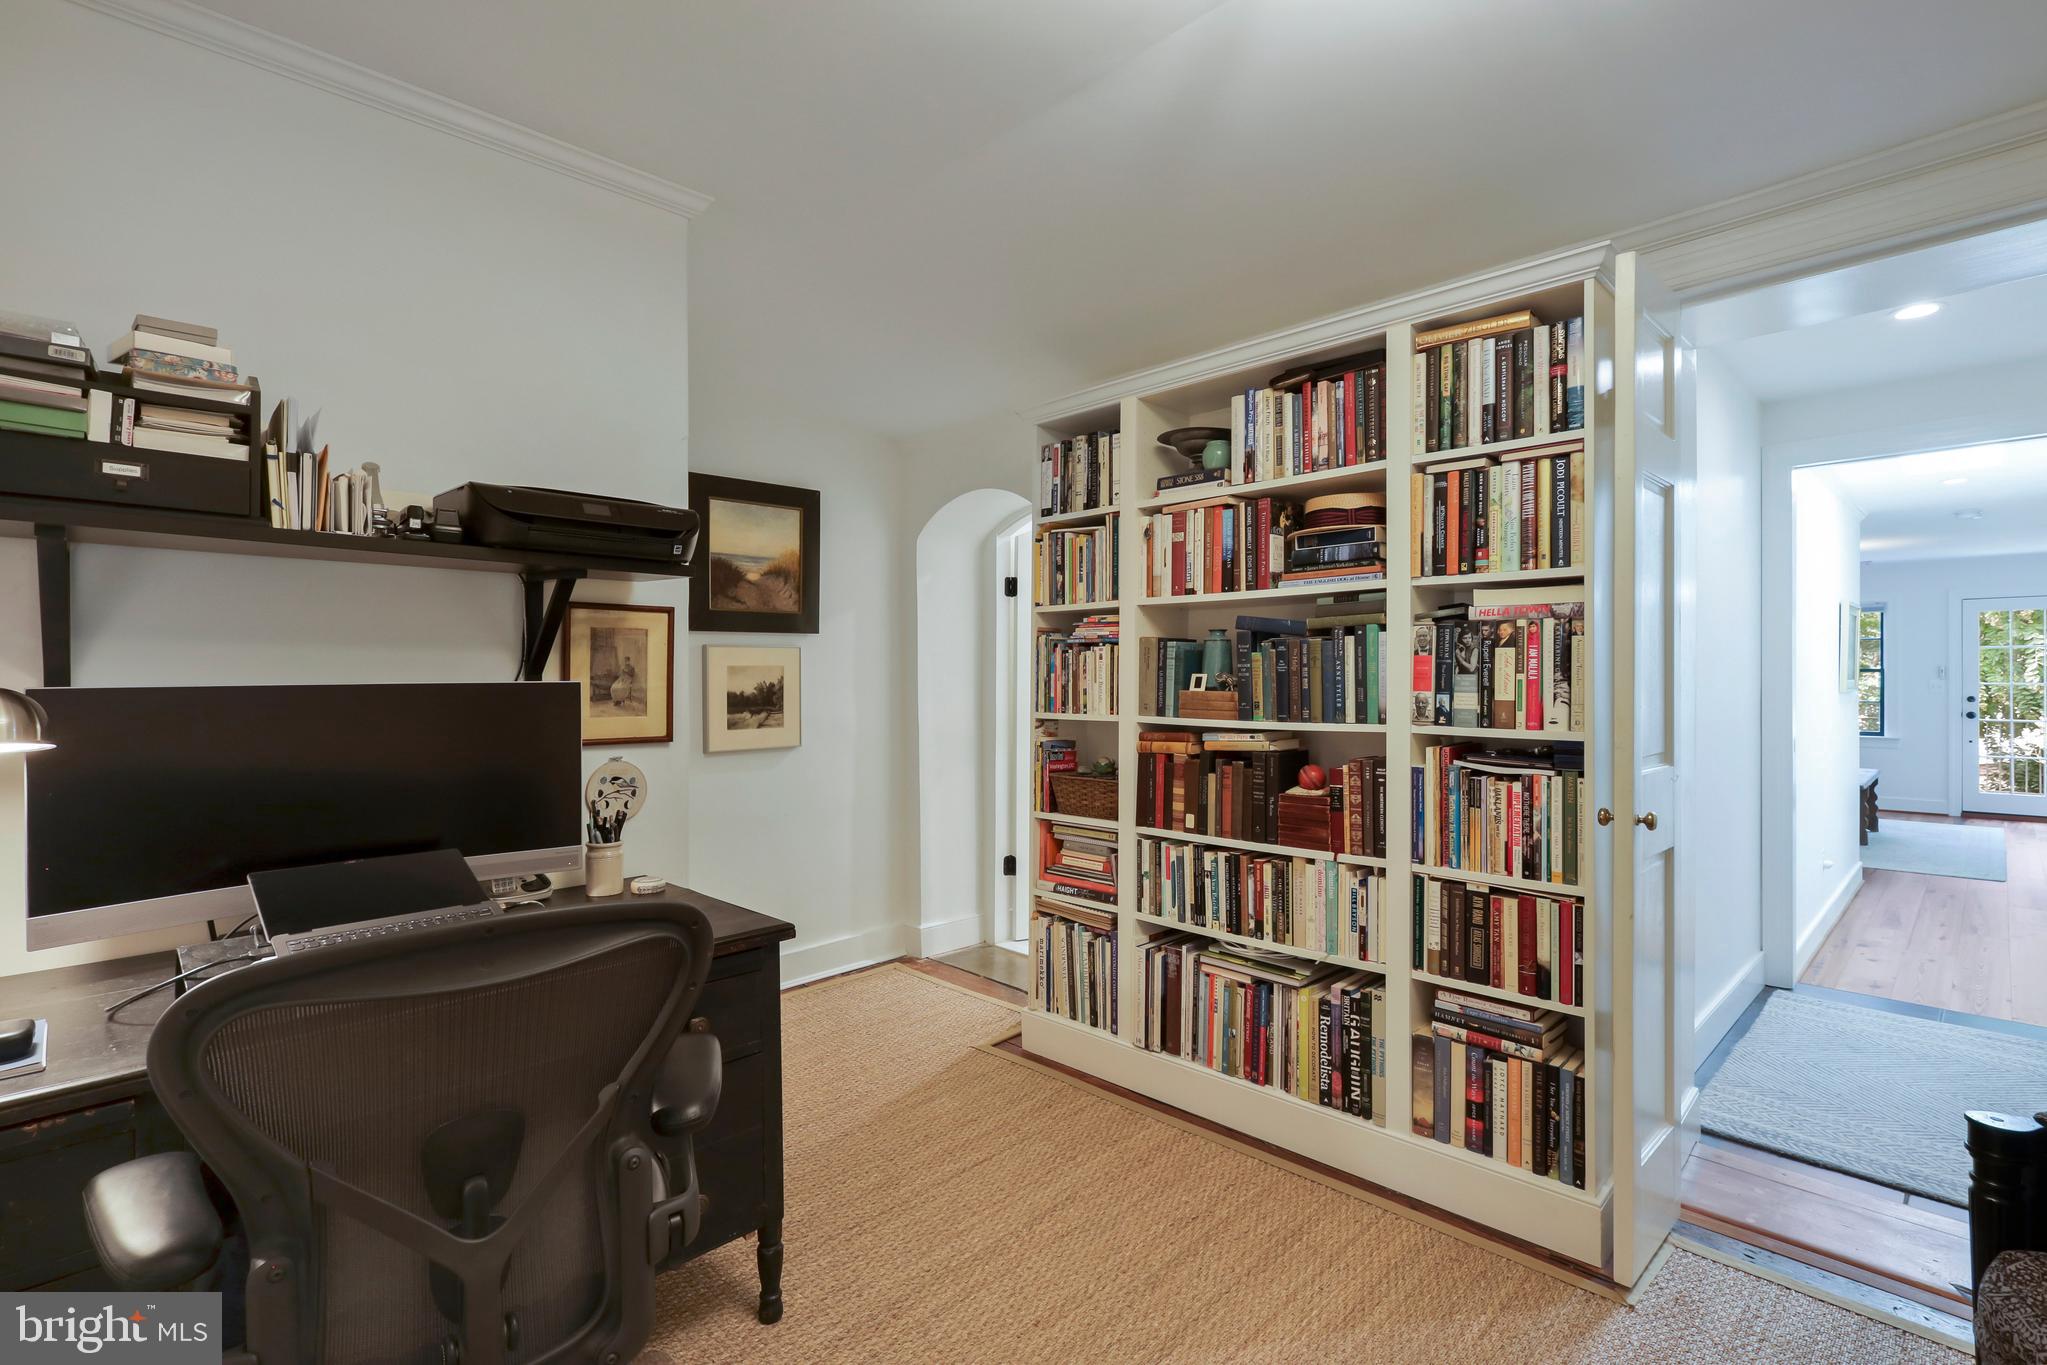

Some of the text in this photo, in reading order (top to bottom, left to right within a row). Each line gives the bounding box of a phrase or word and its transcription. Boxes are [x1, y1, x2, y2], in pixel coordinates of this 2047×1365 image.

[1556, 459, 1566, 479] JODI
[1478, 493, 1484, 501] MY
[1556, 481, 1566, 517] PICOULT
[1479, 607, 1510, 617] HELLA
[1481, 640, 1492, 661] Rupert
[1528, 648, 1538, 657] AM
[1554, 625, 1562, 665] KATHARINE
[1291, 657, 1299, 671] Help
[1528, 658, 1538, 680] MALALA
[1335, 660, 1343, 707] ANNE TYLER
[1481, 664, 1492, 687] Everett
[1443, 782, 1450, 792] OF
[1523, 791, 1530, 801] NO
[1512, 791, 1521, 847] IMPLEMENTATION
[1057, 885, 1079, 895] HAIGHT
[1328, 870, 1337, 899] domino
[1472, 896, 1485, 909] AYN
[1472, 909, 1485, 926] RAND
[1493, 911, 1501, 943] AMY TAN
[1343, 995, 1351, 1026] BRITAIN
[1434, 1012, 1465, 1025] HAMNET
[1319, 1014, 1332, 1091] Remodelista
[1350, 1014, 1361, 1101] GAUGUIN
